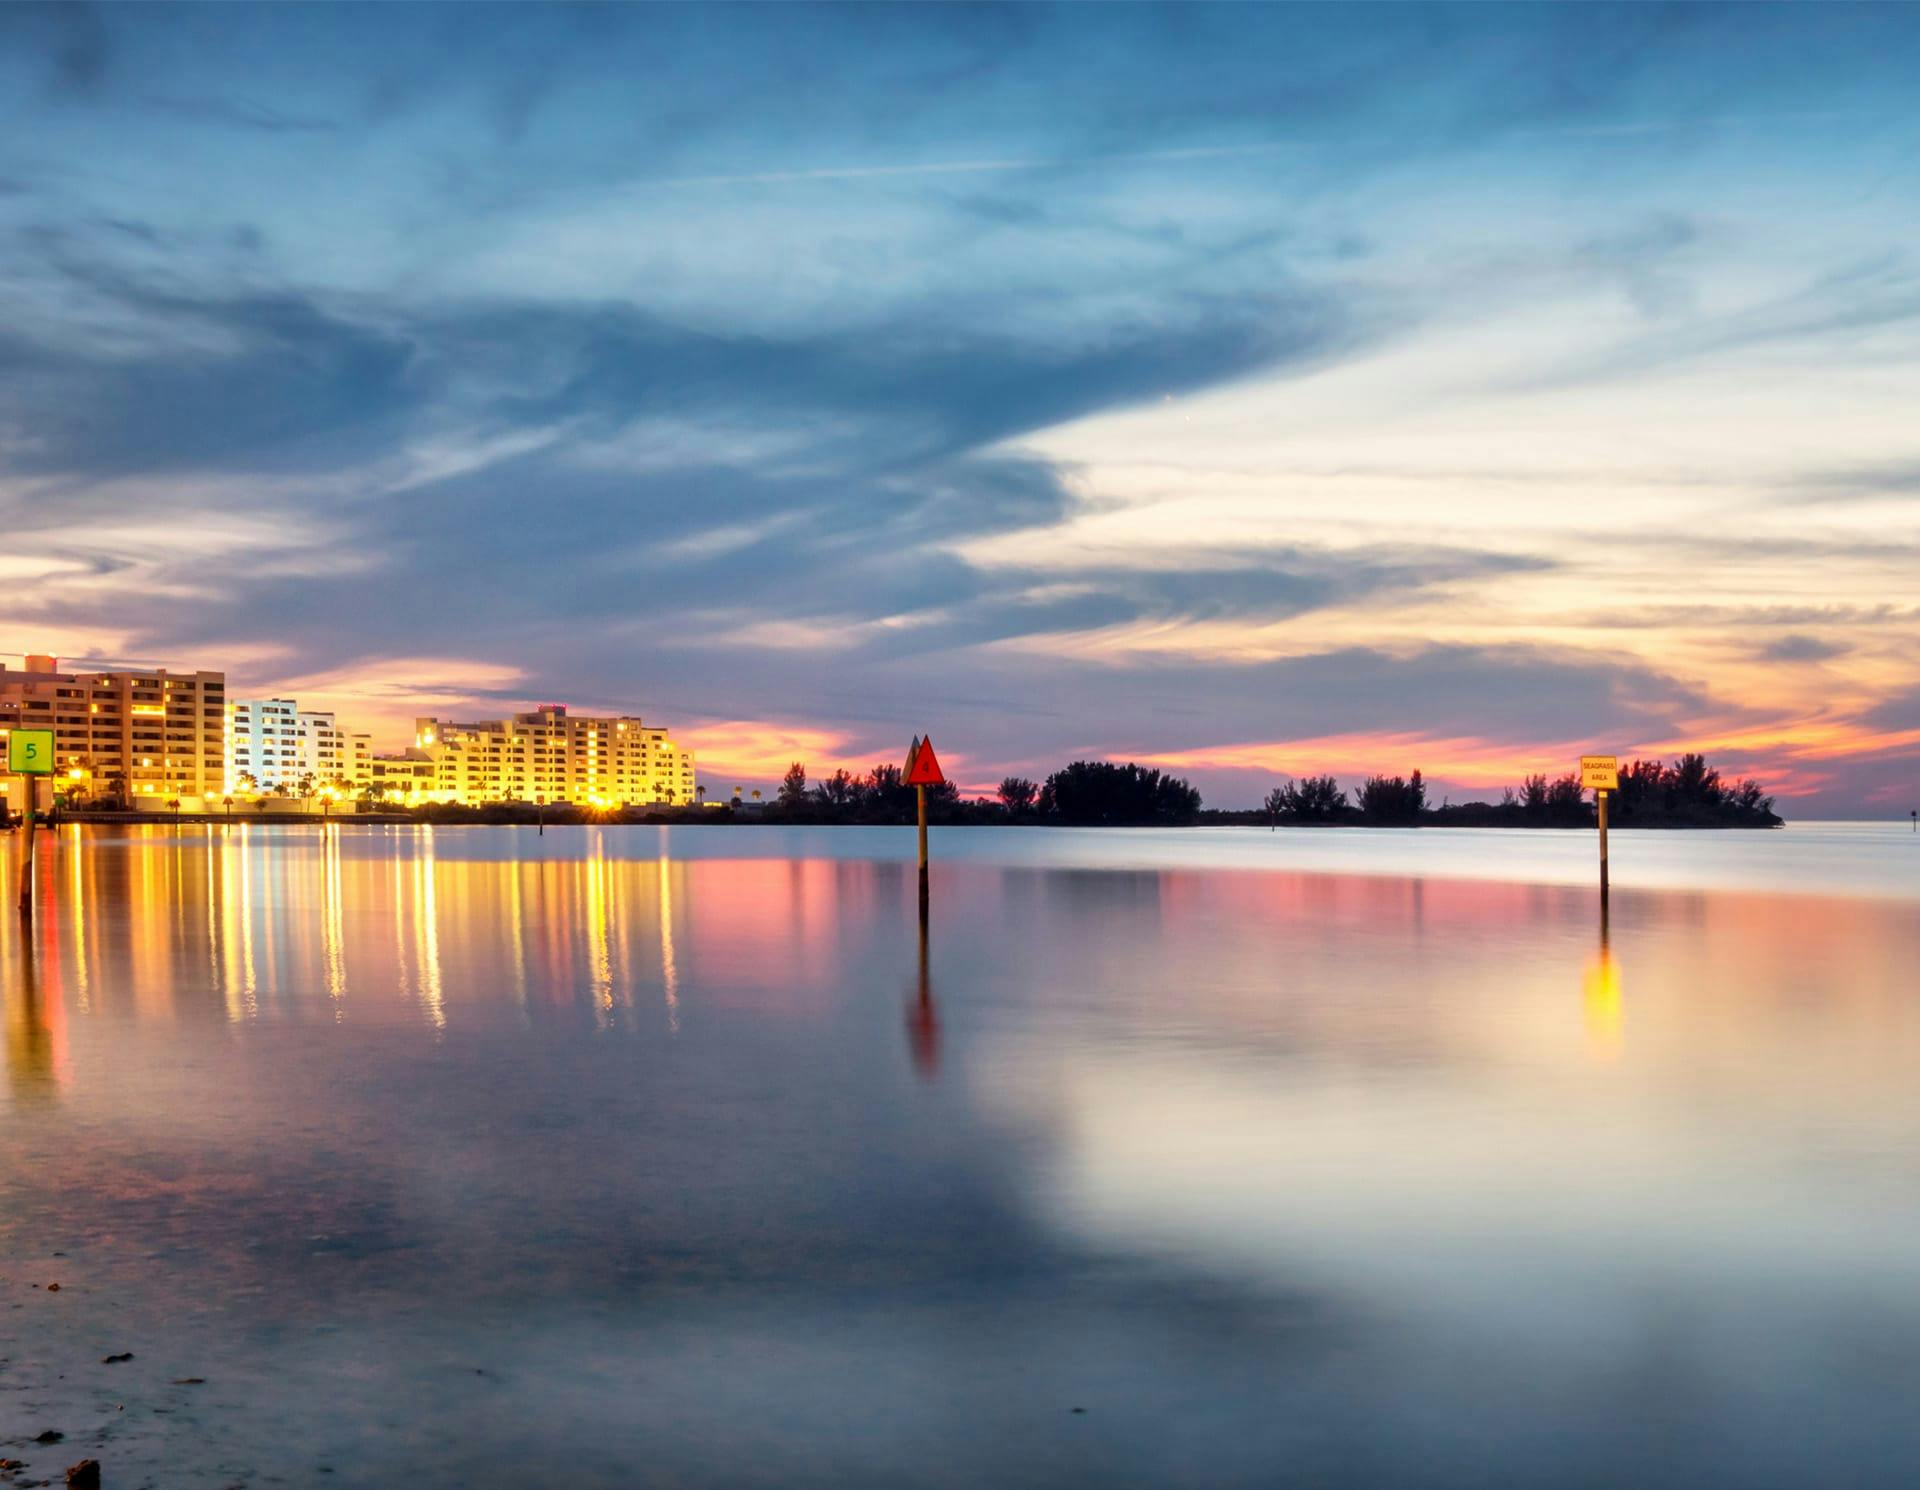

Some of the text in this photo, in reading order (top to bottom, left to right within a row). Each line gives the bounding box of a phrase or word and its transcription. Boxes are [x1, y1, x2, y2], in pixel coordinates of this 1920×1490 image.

[26, 743, 37, 759] 5
[922, 761, 929, 773] 4
[1583, 762, 1615, 770] SEAGRASS
